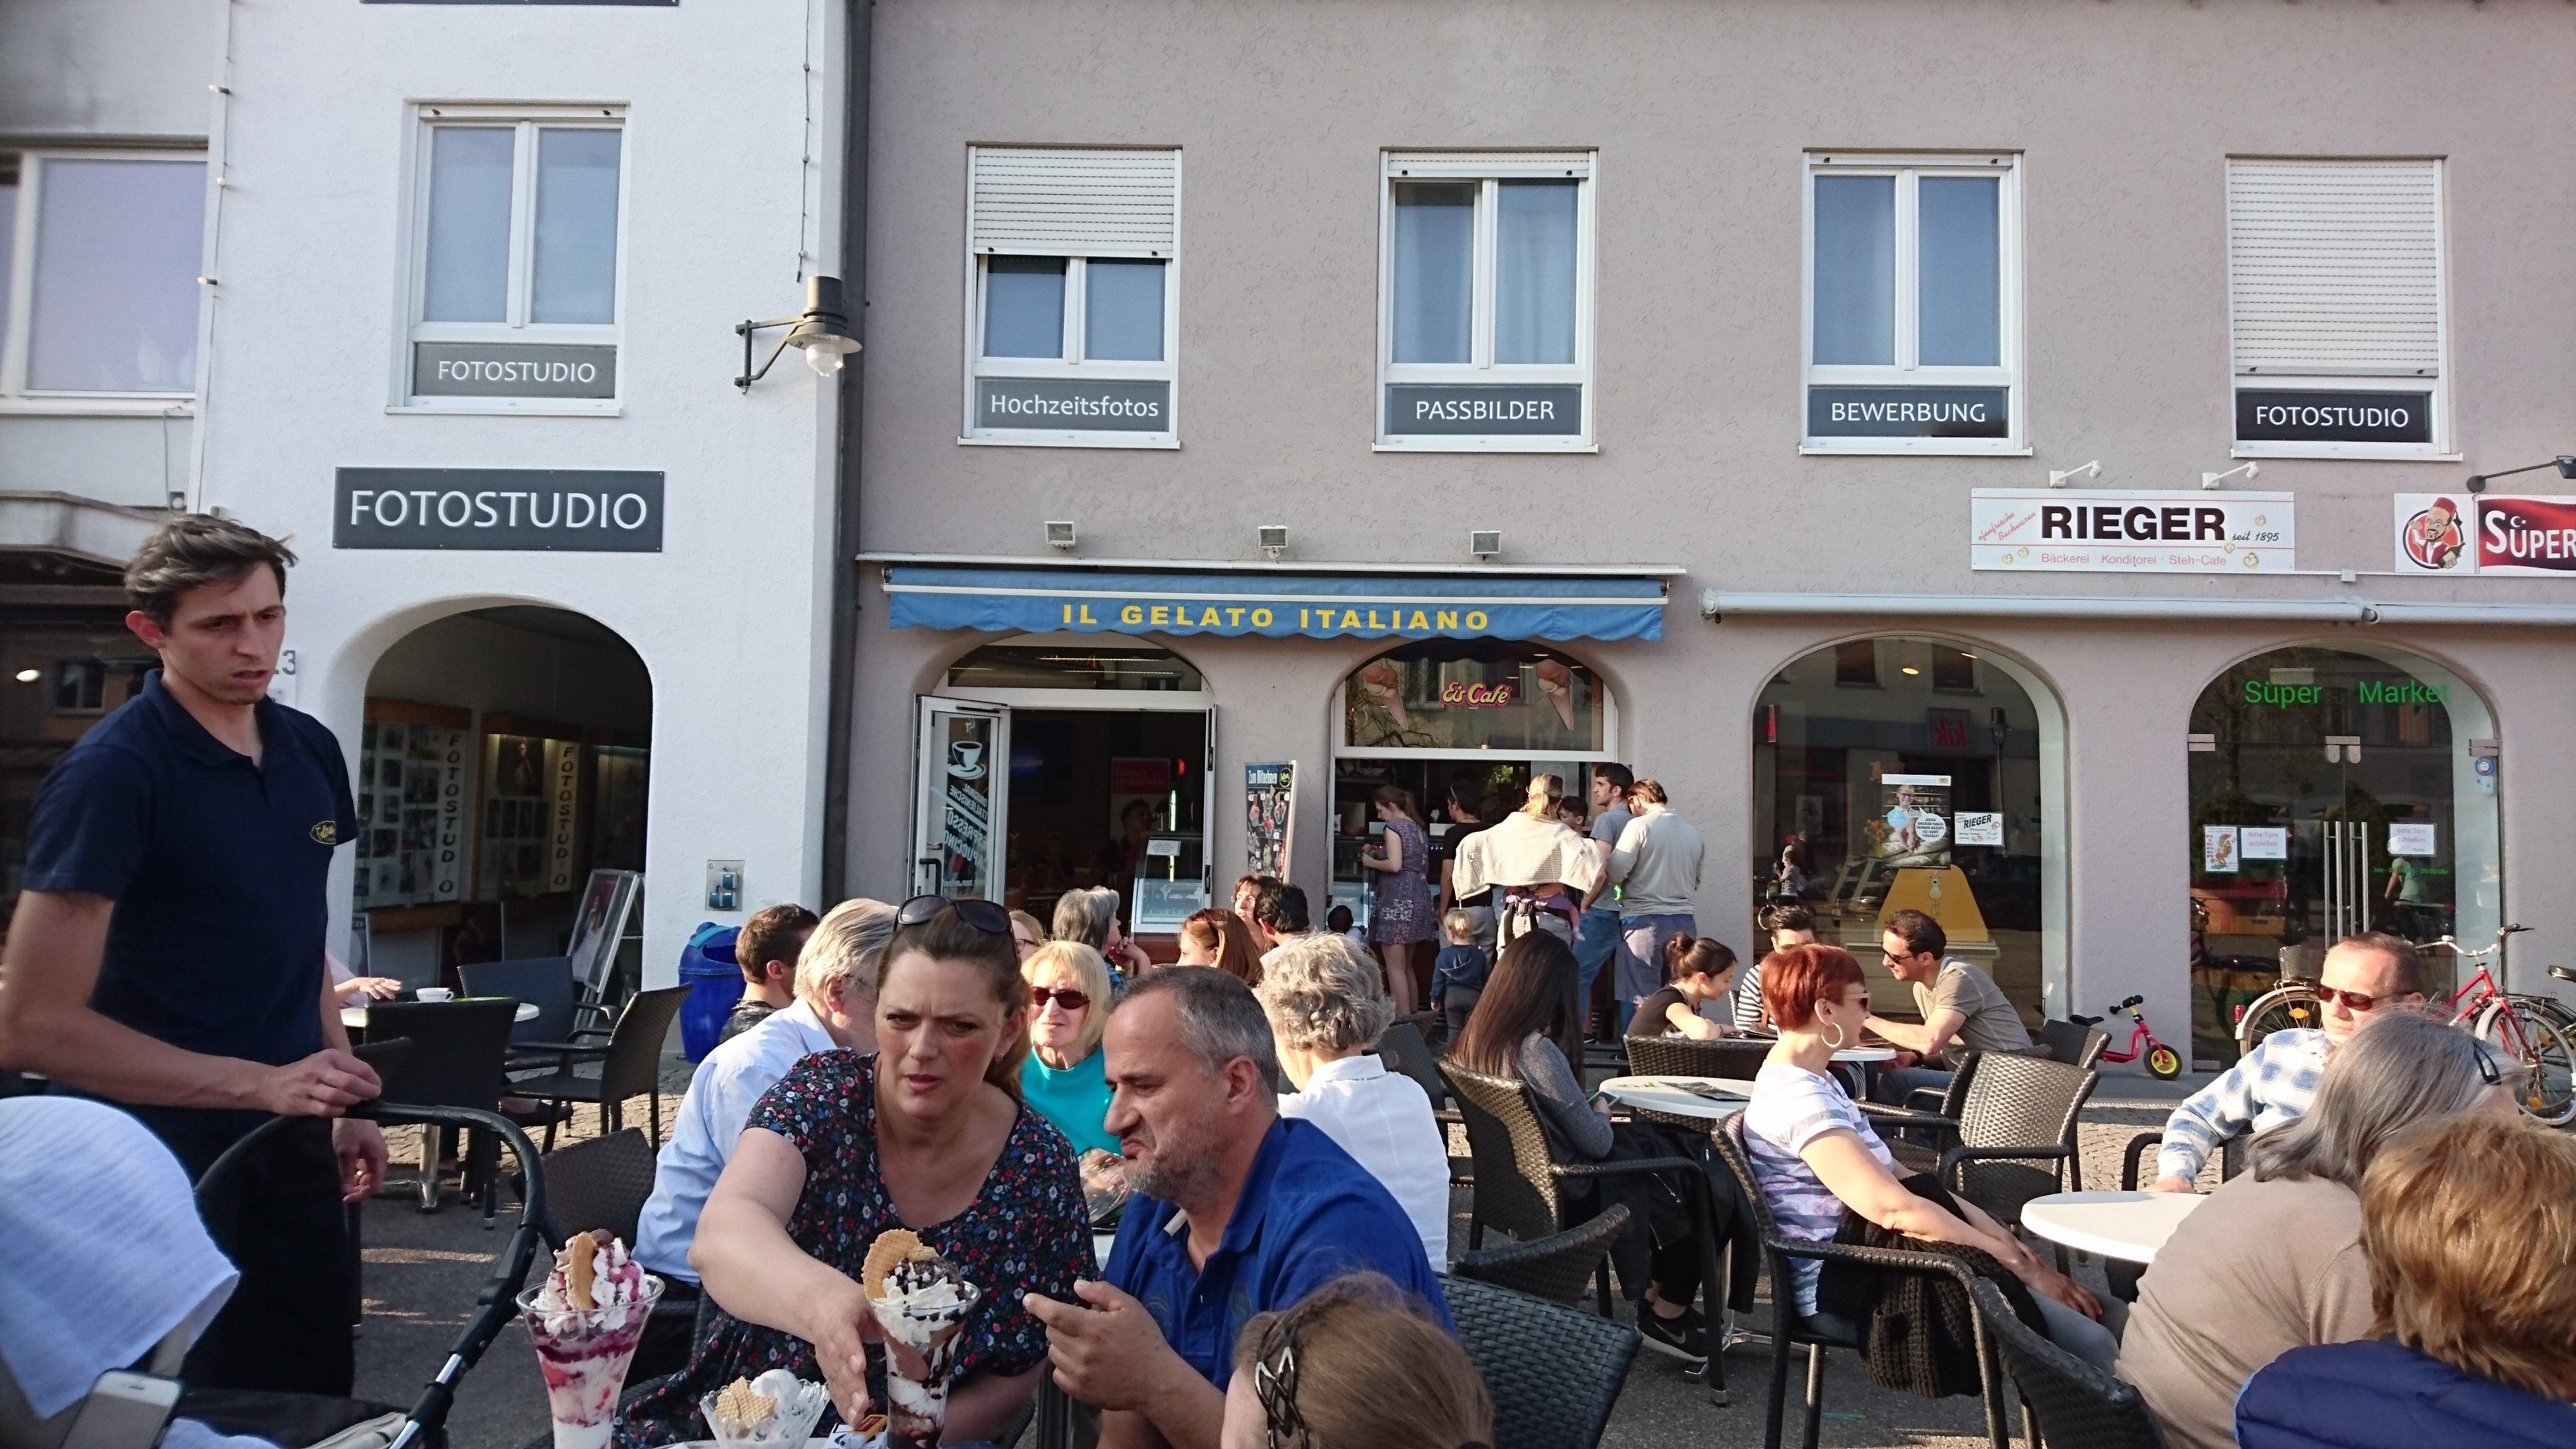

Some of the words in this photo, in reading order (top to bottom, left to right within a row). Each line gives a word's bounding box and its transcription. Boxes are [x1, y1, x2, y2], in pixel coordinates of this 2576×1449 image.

[437, 360, 596, 383] FOTOSTUDIO
[991, 394, 1159, 417] Hochzeitsfotos
[1416, 401, 1554, 420] PASSBILDER
[1831, 402, 1986, 423] BEWERBUNG
[2256, 406, 2409, 427] FOTOSTUDIO
[350, 490, 647, 529] FOTOSTUDIO
[2041, 506, 2226, 541] RIEGER
[2232, 531, 2251, 541] seit
[2255, 531, 2279, 542] 1895
[2041, 553, 2090, 564] Bäckerei
[2102, 554, 2157, 566] Konditorei
[2169, 555, 2226, 566] Steh-Cafe
[1063, 604, 1096, 624] IL
[1121, 605, 1273, 627] GELATO
[1301, 608, 1488, 630] ITALIANO
[1443, 682, 1466, 703] Eis
[1468, 683, 1509, 704] Café
[2245, 680, 2322, 709] Süper
[2359, 680, 2450, 704] Market
[1964, 814, 1992, 828] RIEGER
